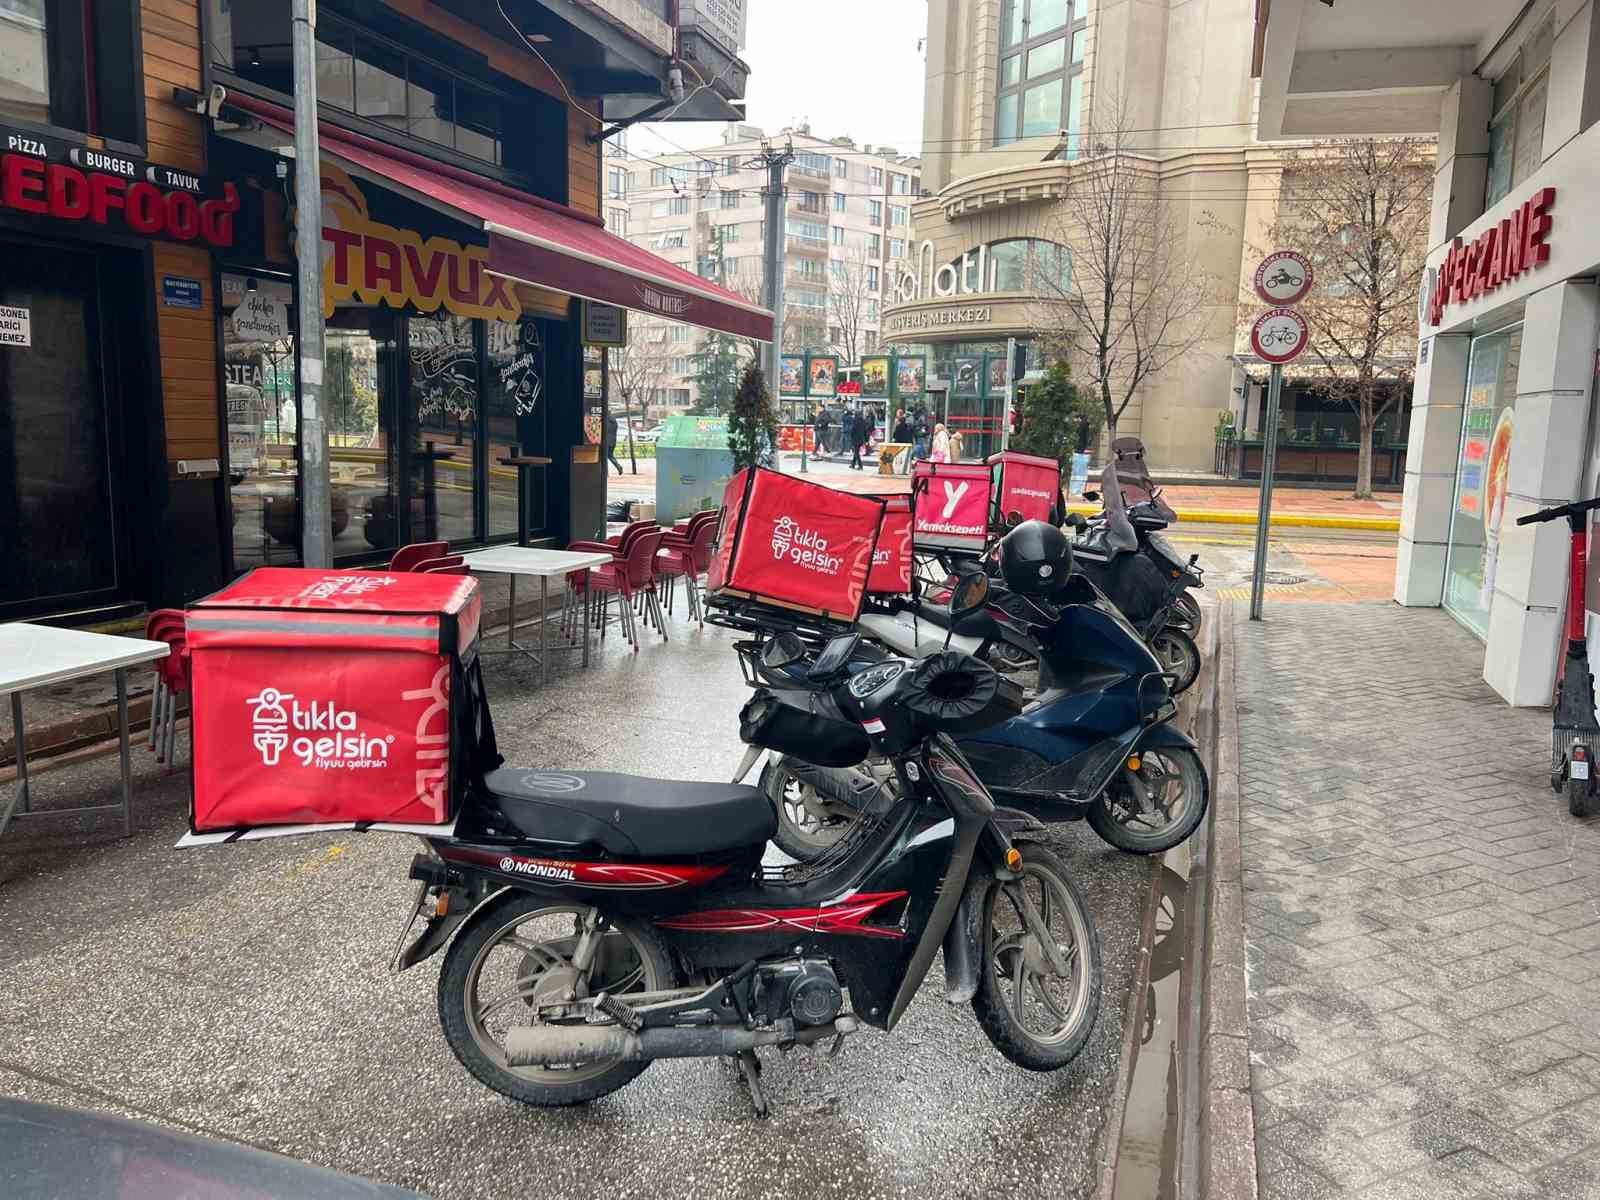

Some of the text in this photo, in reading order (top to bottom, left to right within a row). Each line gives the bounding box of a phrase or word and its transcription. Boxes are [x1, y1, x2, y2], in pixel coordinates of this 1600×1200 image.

[8, 135, 47, 157] PİZZA
[86, 151, 135, 176] BURGER
[166, 171, 200, 191] TAVUK
[942, 480, 969, 519] Y
[917, 519, 984, 535] Yemeksepeti
[293, 700, 357, 731] tıkla
[514, 862, 576, 881] MONDIAL
